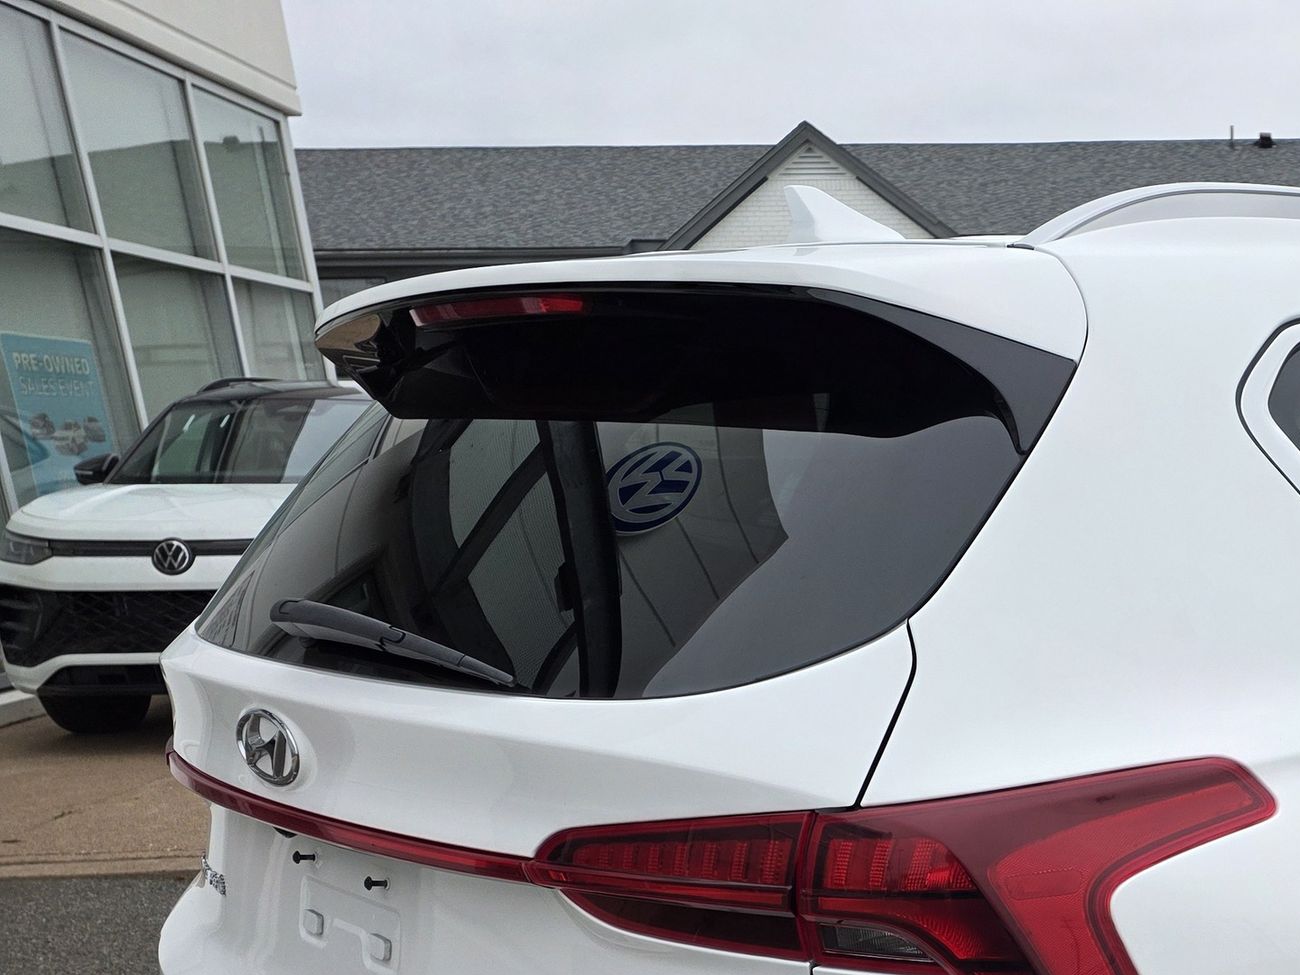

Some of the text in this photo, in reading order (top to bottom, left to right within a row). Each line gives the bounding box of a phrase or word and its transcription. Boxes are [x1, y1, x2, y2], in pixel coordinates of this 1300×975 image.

[12, 352, 90, 375] PRE-OWNED
[20, 376, 94, 399] SALES EVENT
